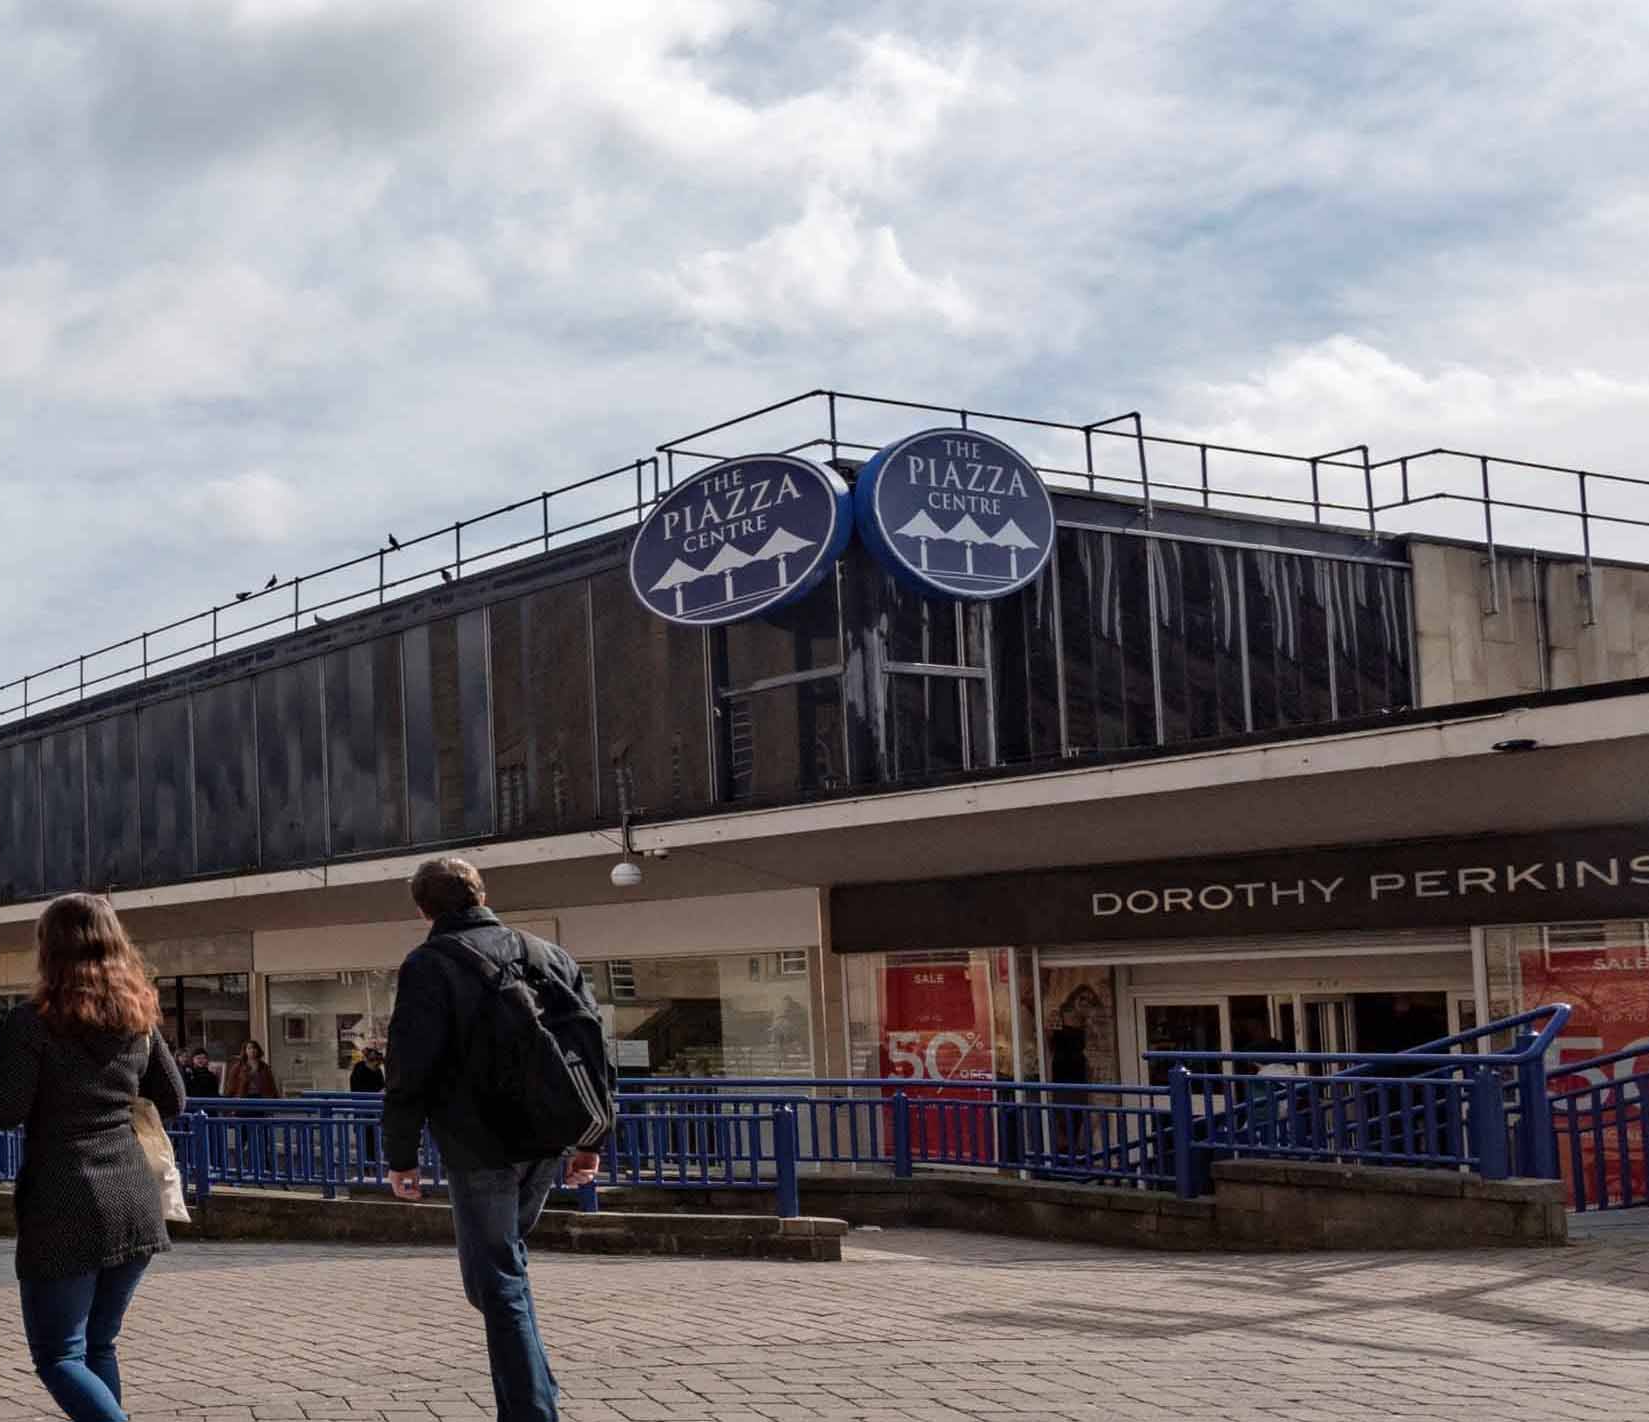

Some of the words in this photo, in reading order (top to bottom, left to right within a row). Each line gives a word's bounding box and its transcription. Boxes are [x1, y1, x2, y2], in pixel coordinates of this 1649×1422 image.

[942, 439, 981, 461] THE
[699, 469, 743, 496] THE
[907, 455, 1029, 498] PIAZZA
[663, 473, 801, 540] PIAZZA
[928, 491, 1002, 516] CENTRE
[683, 514, 768, 553] CENTRE
[1092, 877, 1345, 916] DOROTHY
[1369, 855, 1649, 900] PERKINS
[1593, 957, 1649, 971] SALE
[913, 973, 945, 985] SALE
